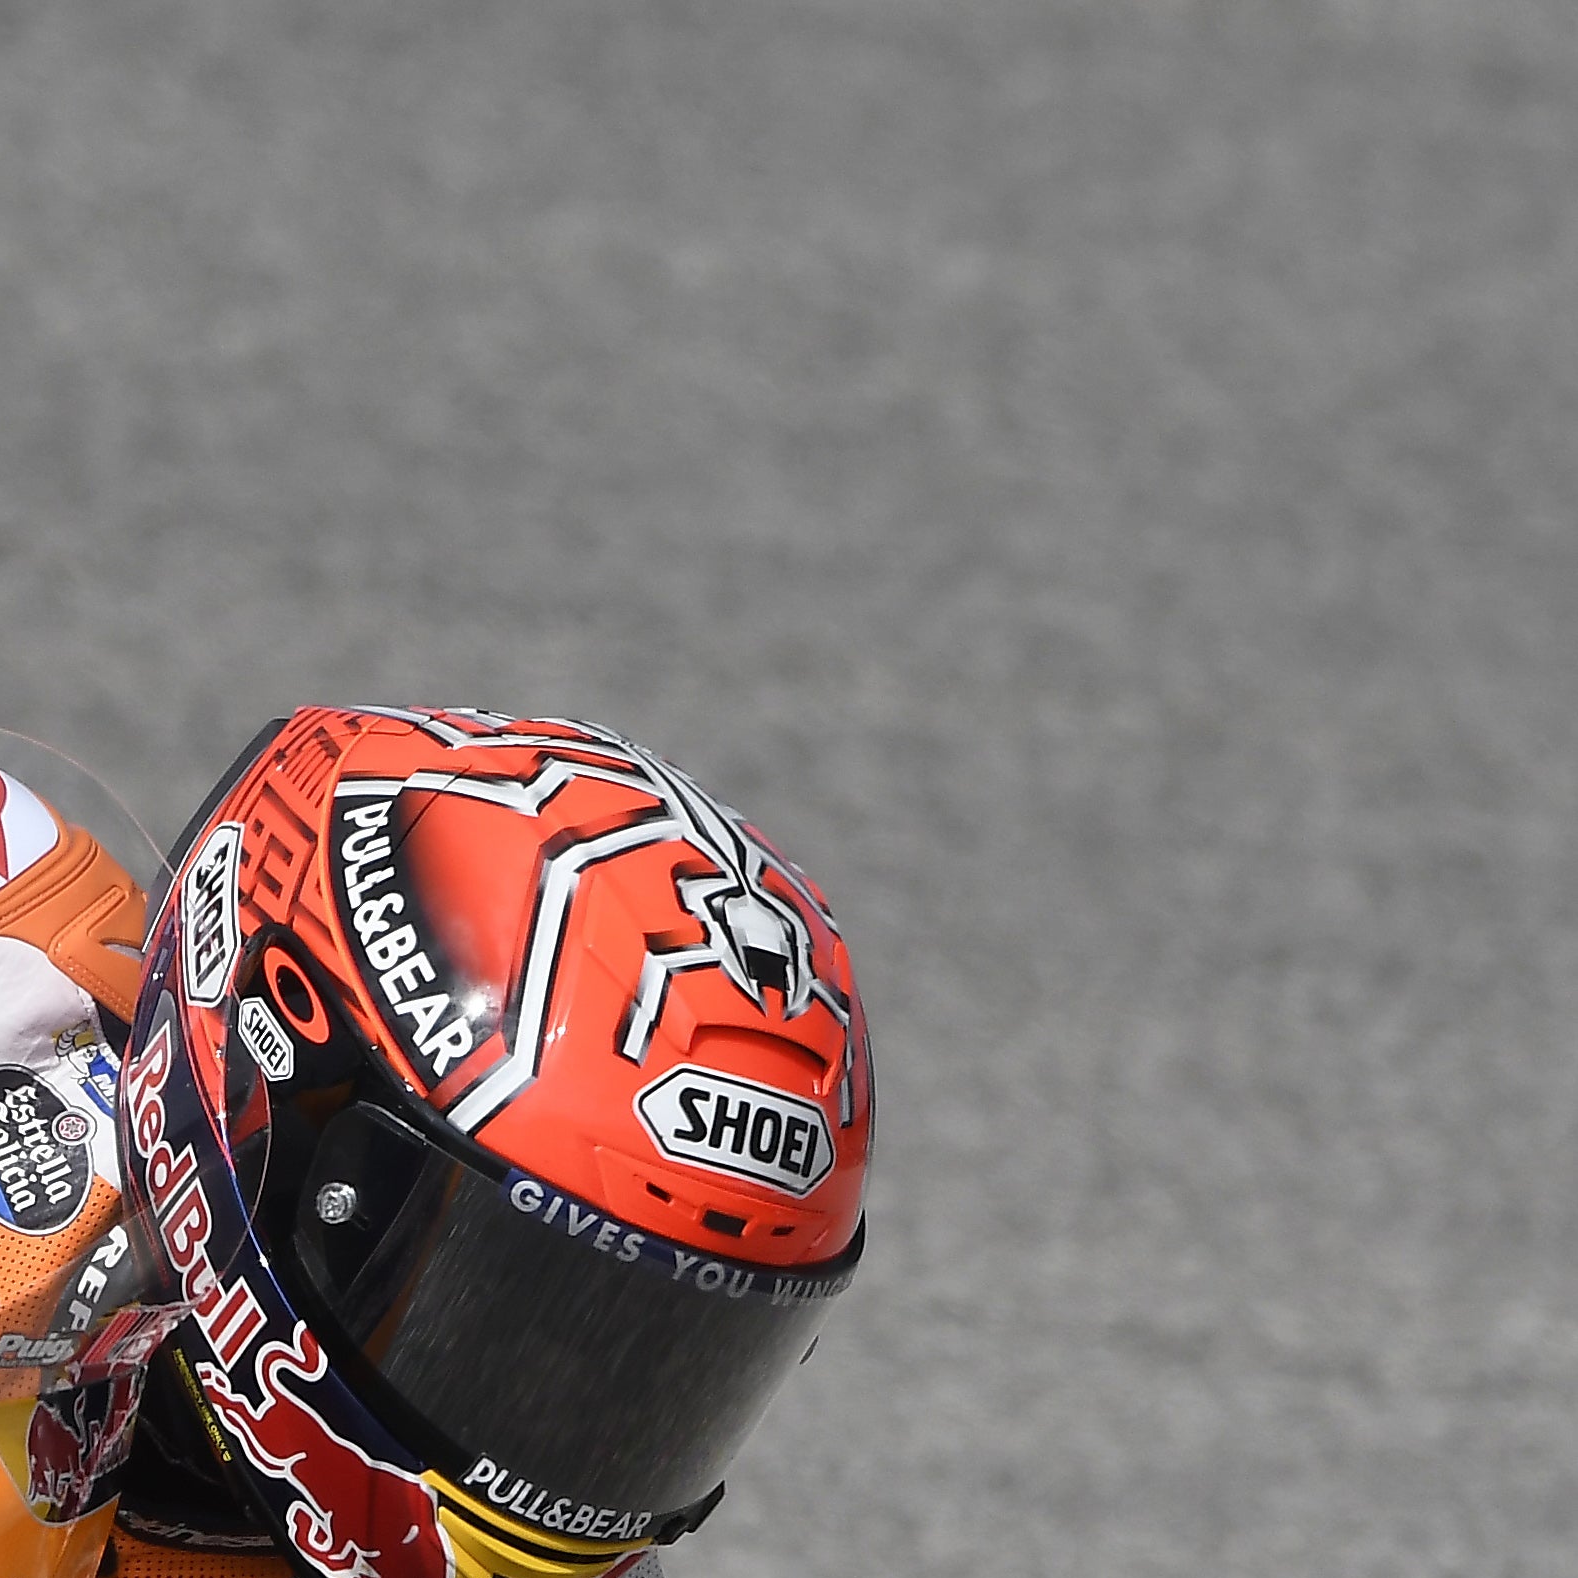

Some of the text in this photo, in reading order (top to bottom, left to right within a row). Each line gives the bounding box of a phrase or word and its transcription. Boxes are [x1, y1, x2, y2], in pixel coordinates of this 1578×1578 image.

[341, 799, 473, 1077] PULL&BEAR
[245, 1006, 287, 1072] SHOEI
[4, 1085, 73, 1205] Estrella
[128, 1019, 198, 1218] Red
[674, 1085, 821, 1175] SHOEI
[159, 1176, 268, 1373] Bull
[509, 1179, 646, 1263] GIVES
[671, 1249, 755, 1299] YOU
[463, 1456, 653, 1540] PULL&BEAR
